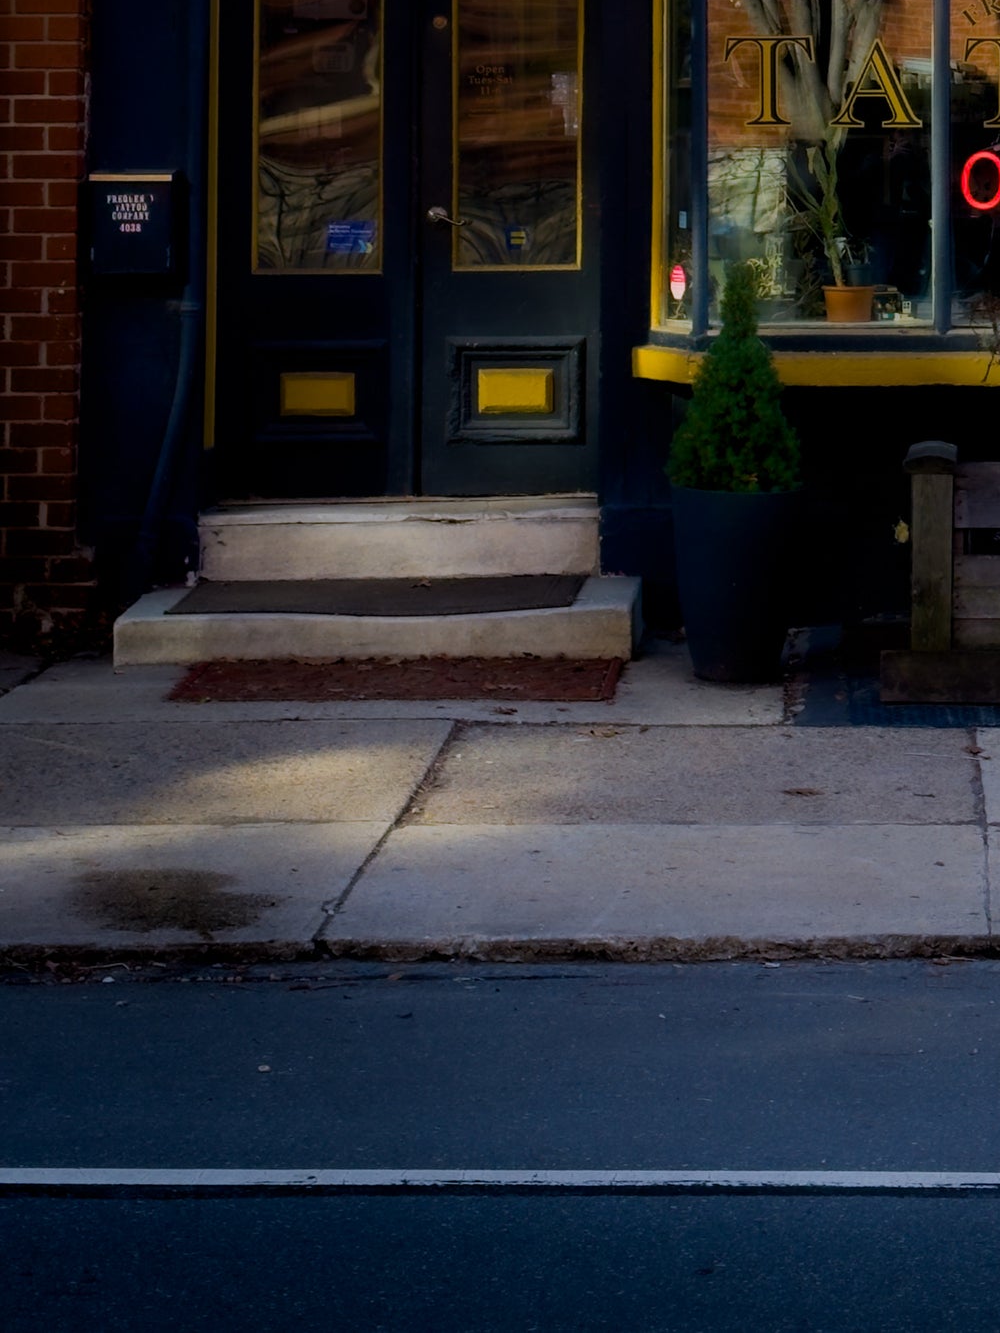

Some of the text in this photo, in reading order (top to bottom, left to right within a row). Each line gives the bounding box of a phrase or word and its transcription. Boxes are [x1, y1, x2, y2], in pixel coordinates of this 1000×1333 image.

[475, 64, 505, 76] Open
[115, 203, 148, 212] TATTOO
[111, 211, 150, 221] COMPANY
[119, 223, 142, 233] 4038
